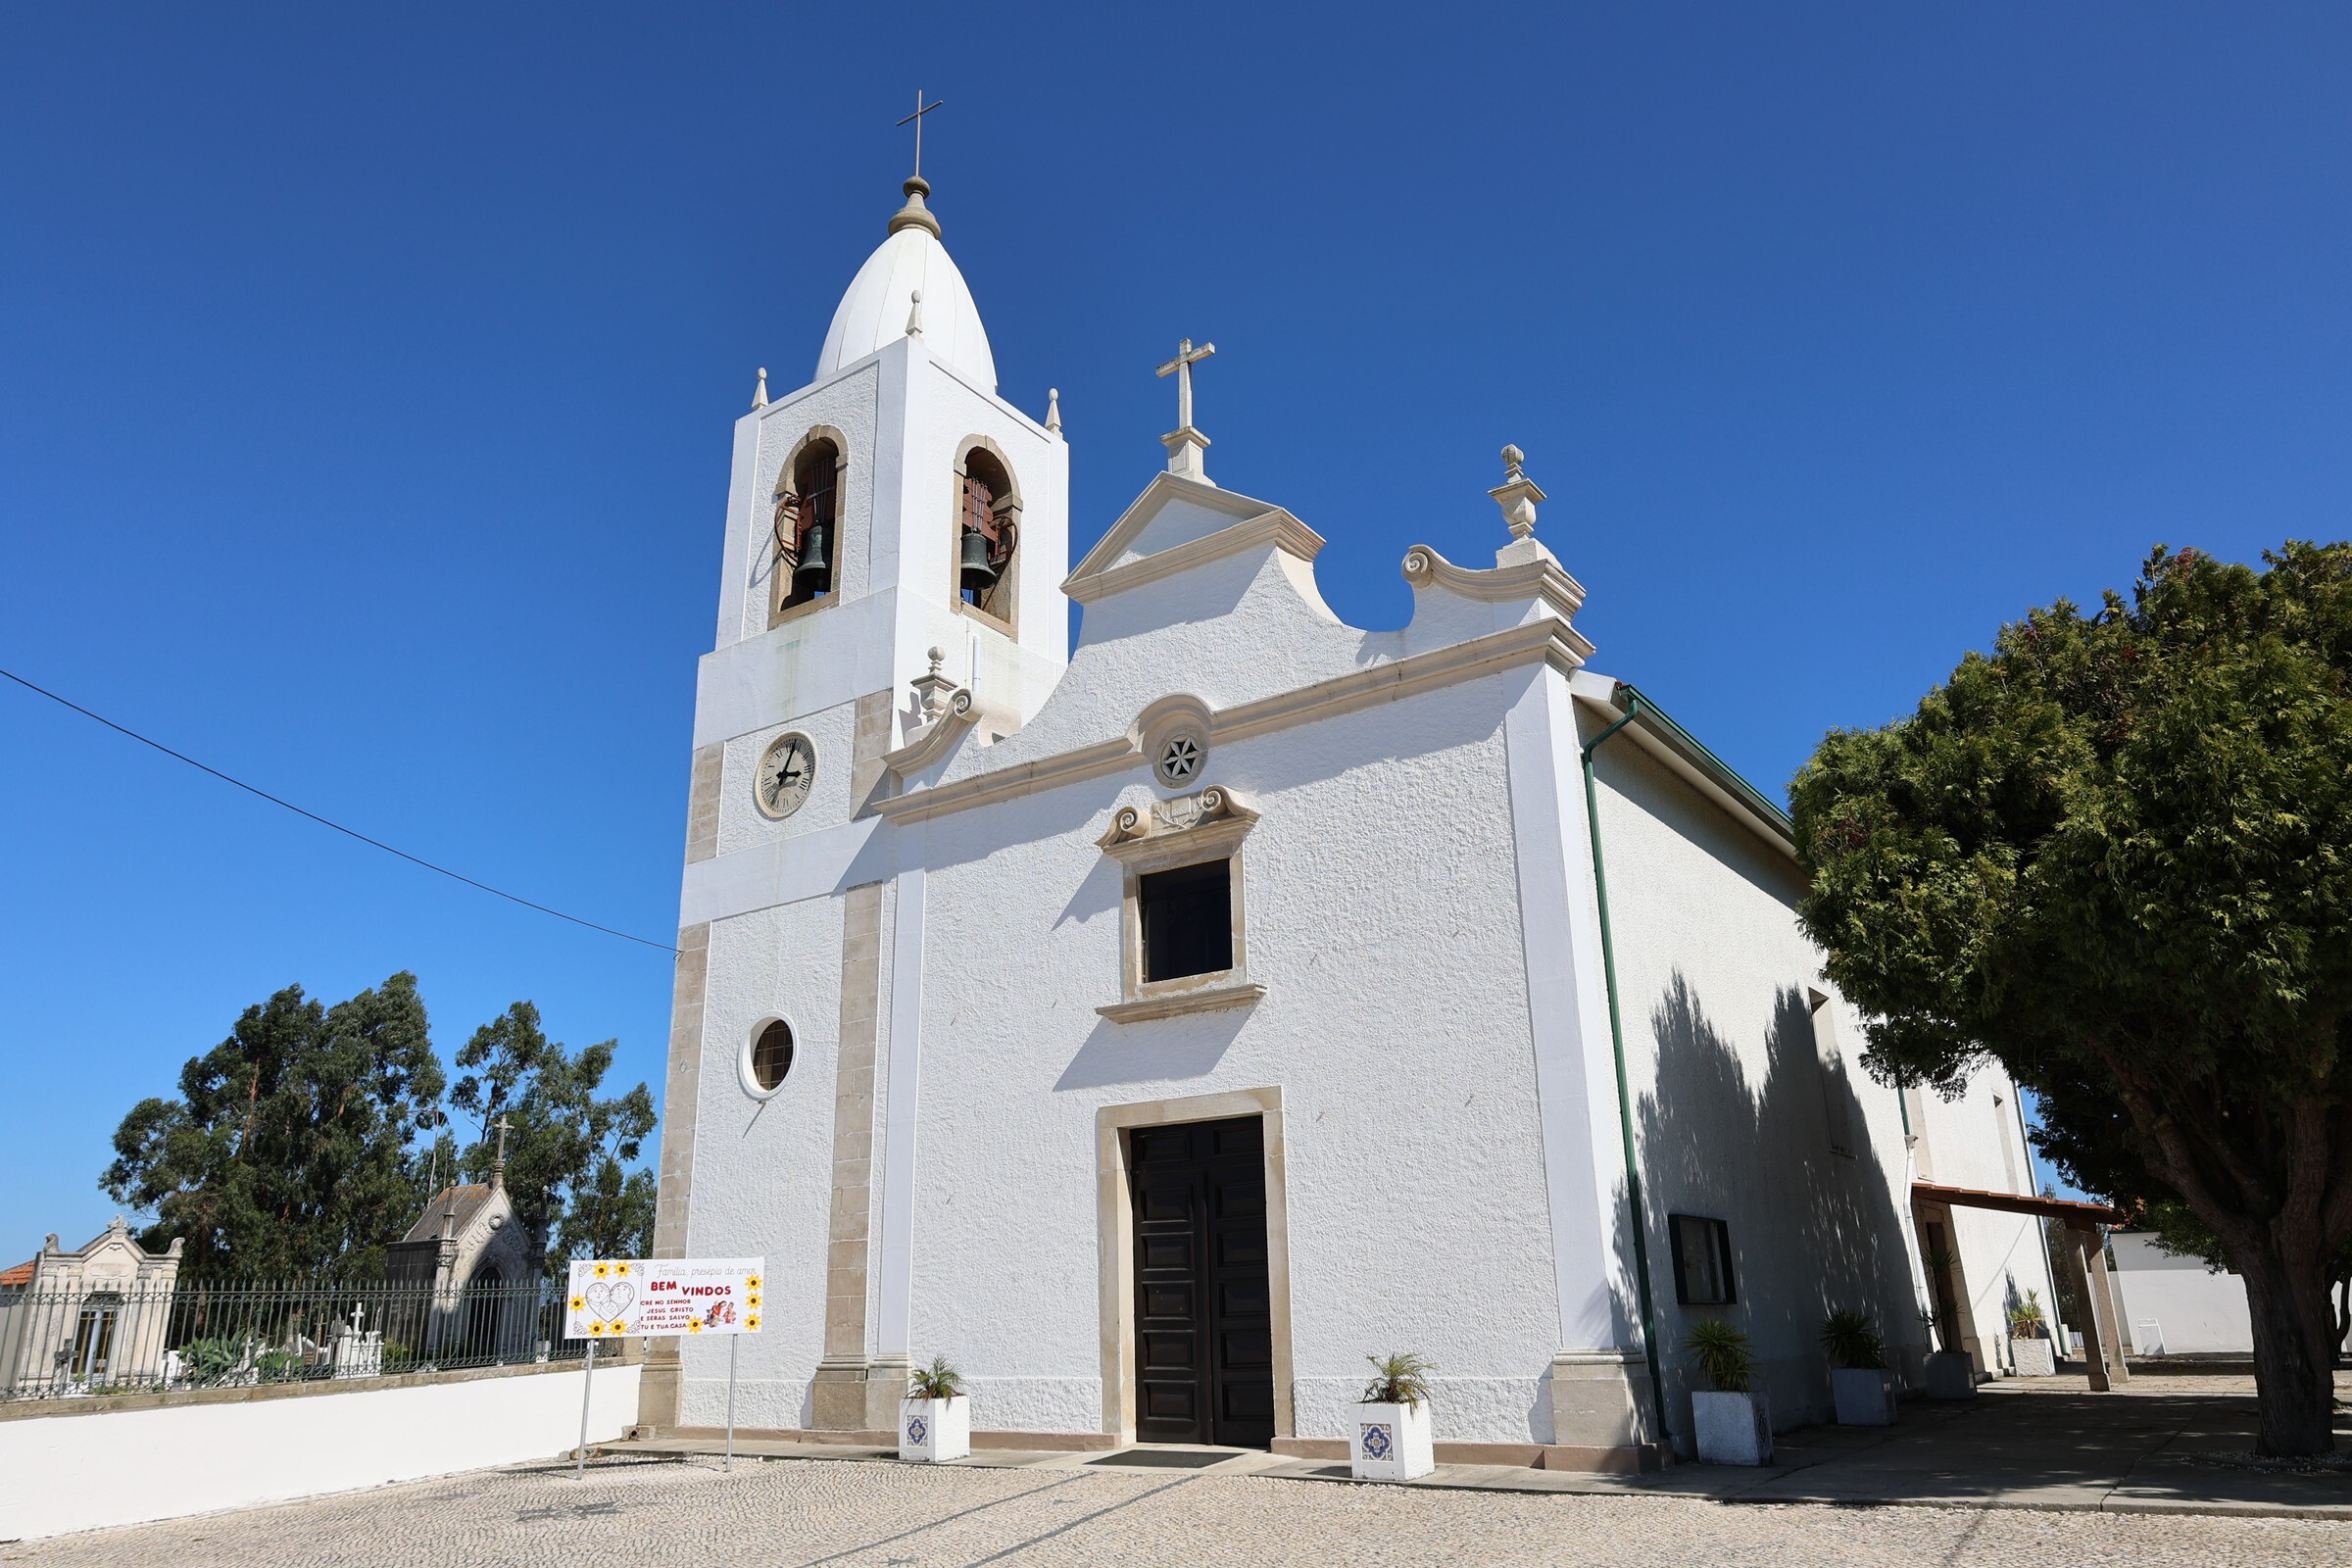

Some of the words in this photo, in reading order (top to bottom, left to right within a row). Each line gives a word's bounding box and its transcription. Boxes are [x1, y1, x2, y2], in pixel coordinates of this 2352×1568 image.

[725, 1266, 735, 1275] de
[650, 1281, 677, 1292] BEM
[682, 1286, 731, 1297] VINDOS
